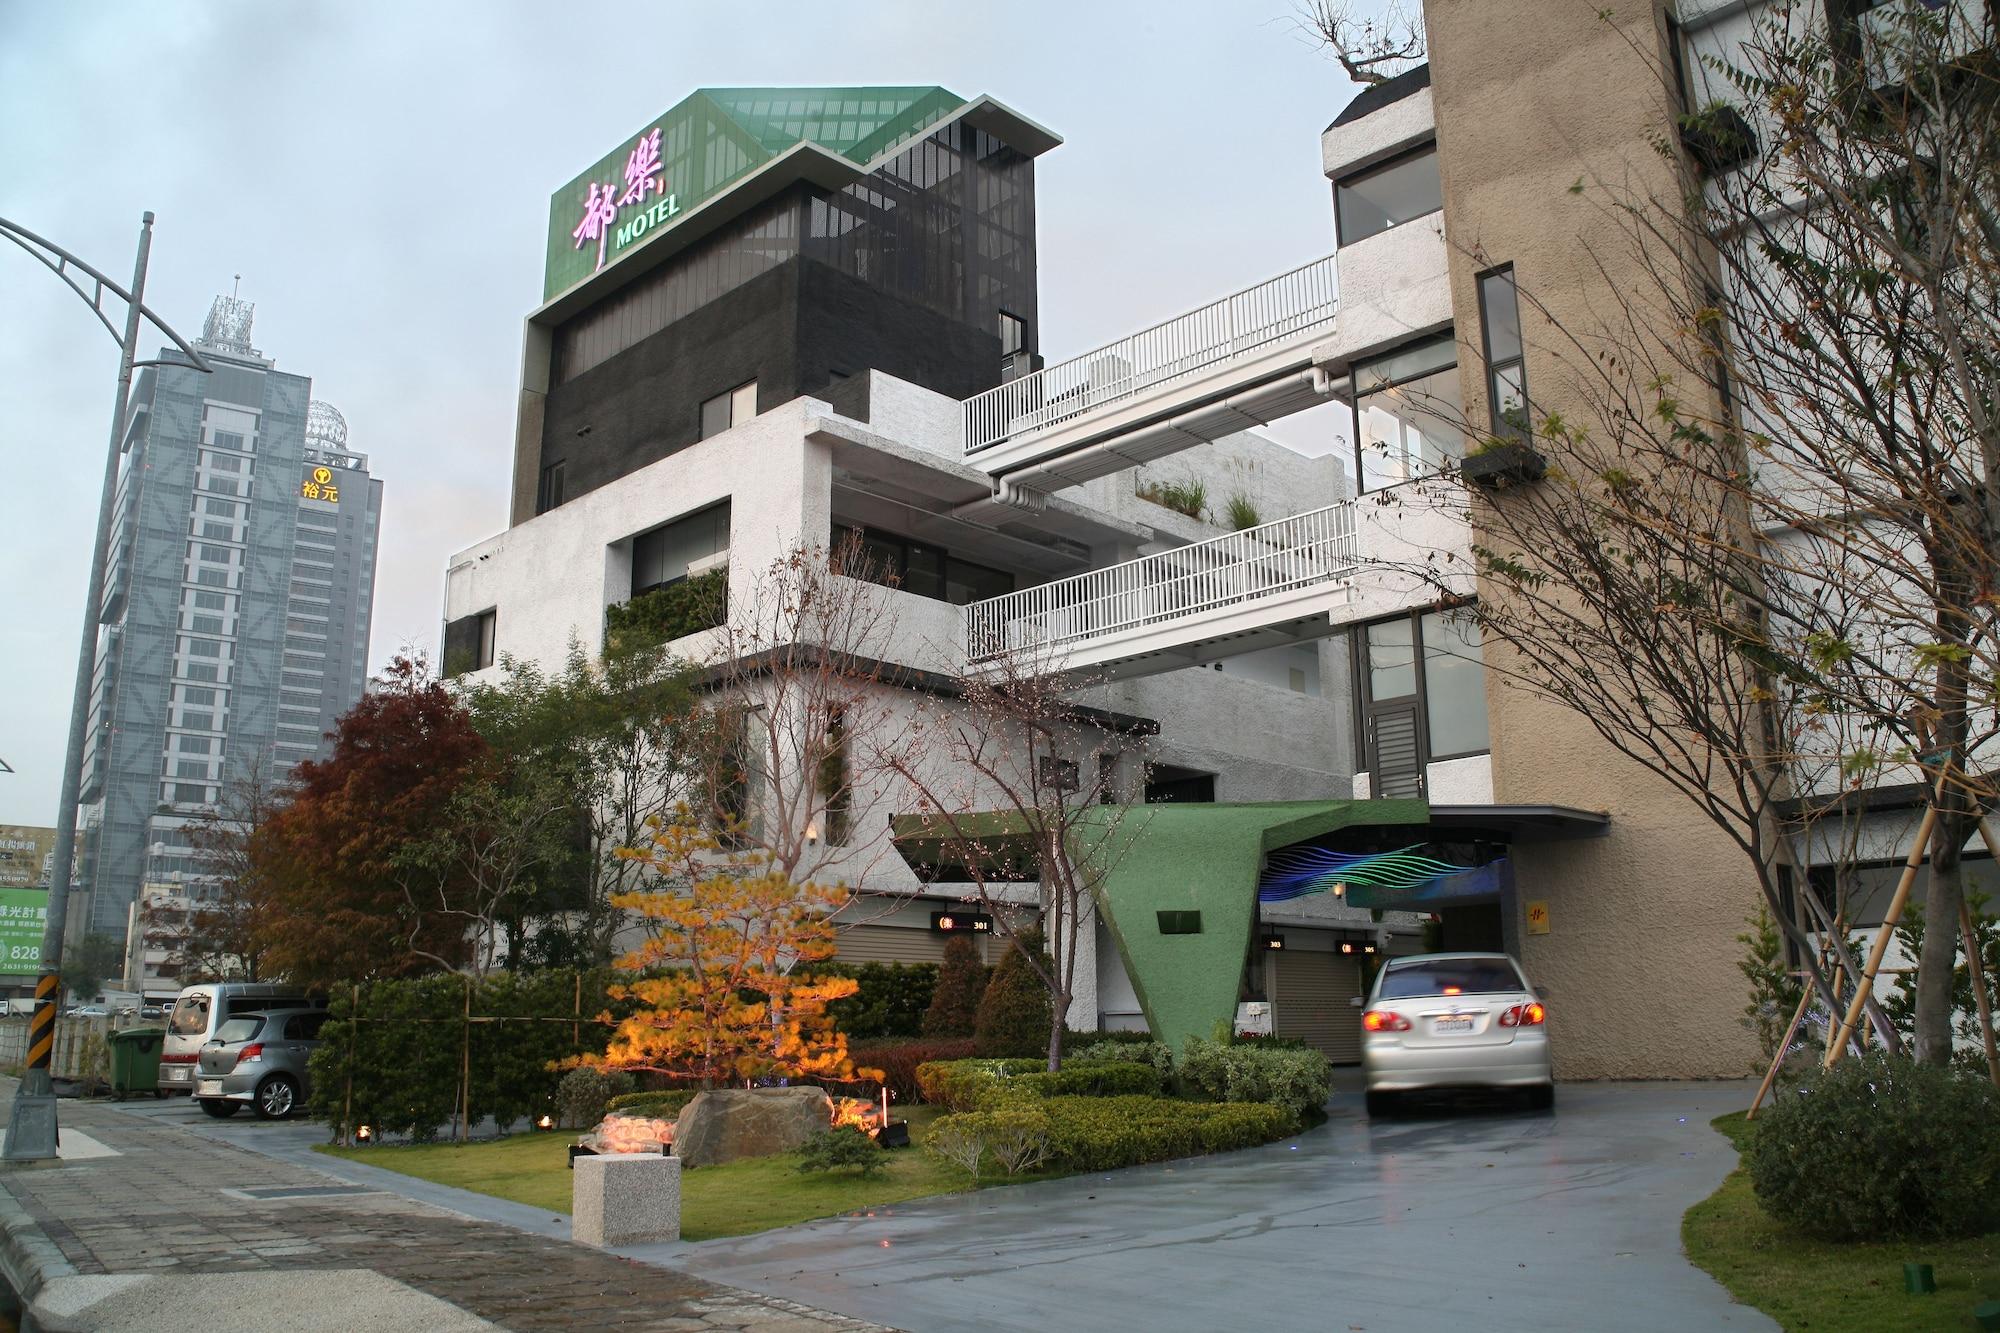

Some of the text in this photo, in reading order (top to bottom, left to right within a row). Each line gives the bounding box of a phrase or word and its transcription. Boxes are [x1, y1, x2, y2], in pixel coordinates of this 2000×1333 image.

[616, 194, 680, 249] MOTEL
[303, 481, 338, 502] 裕元
[11, 946, 39, 960] 828
